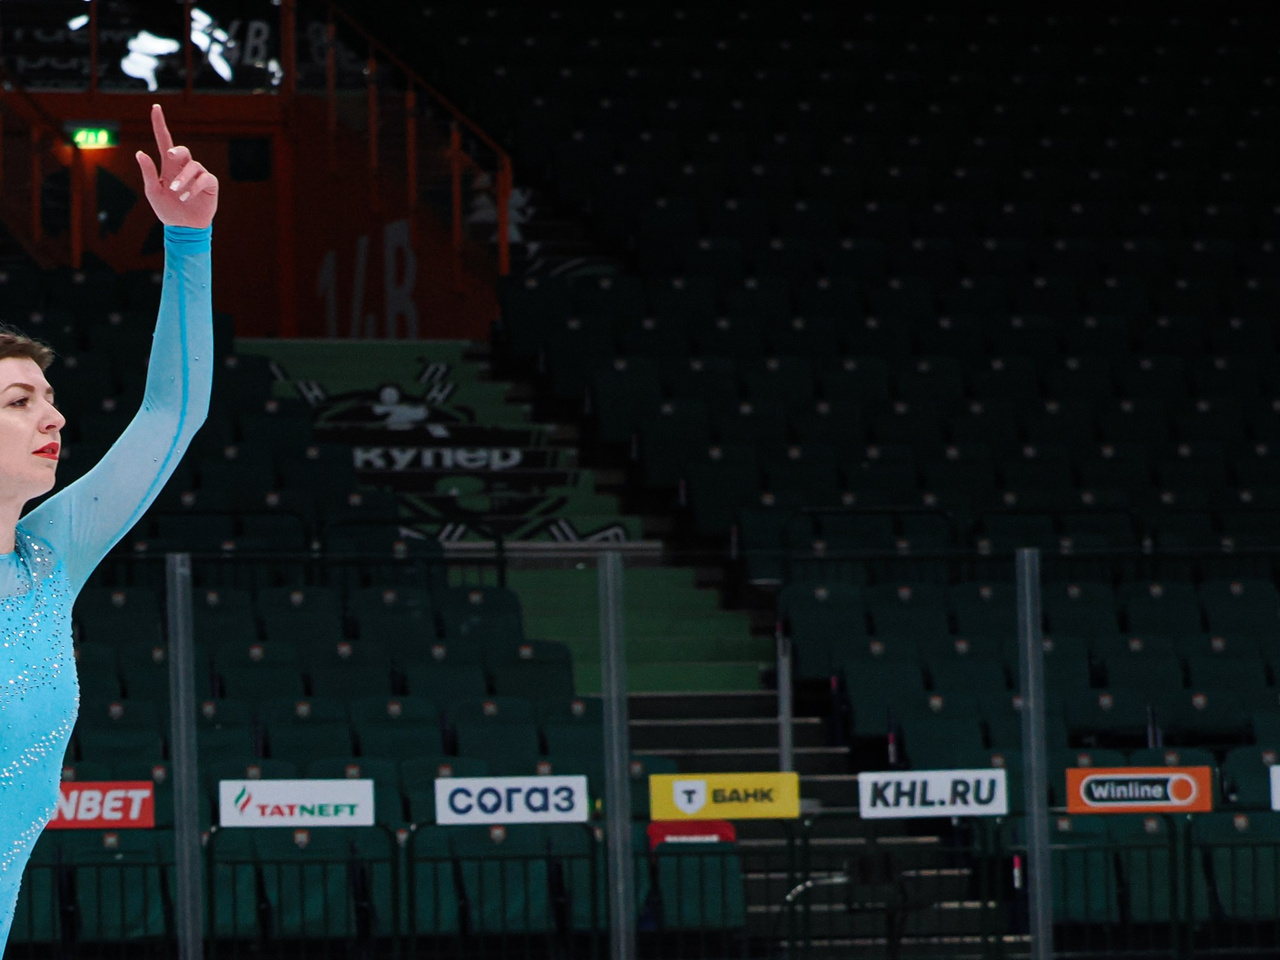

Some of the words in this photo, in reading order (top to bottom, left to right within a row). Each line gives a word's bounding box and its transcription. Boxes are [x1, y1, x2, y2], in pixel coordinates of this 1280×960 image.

[448, 786, 576, 816] согаз
[711, 787, 774, 804] БАНК
[869, 778, 998, 808] KHL.RU
[1091, 779, 1166, 801] Winline
[257, 802, 359, 818] TATNEFT
